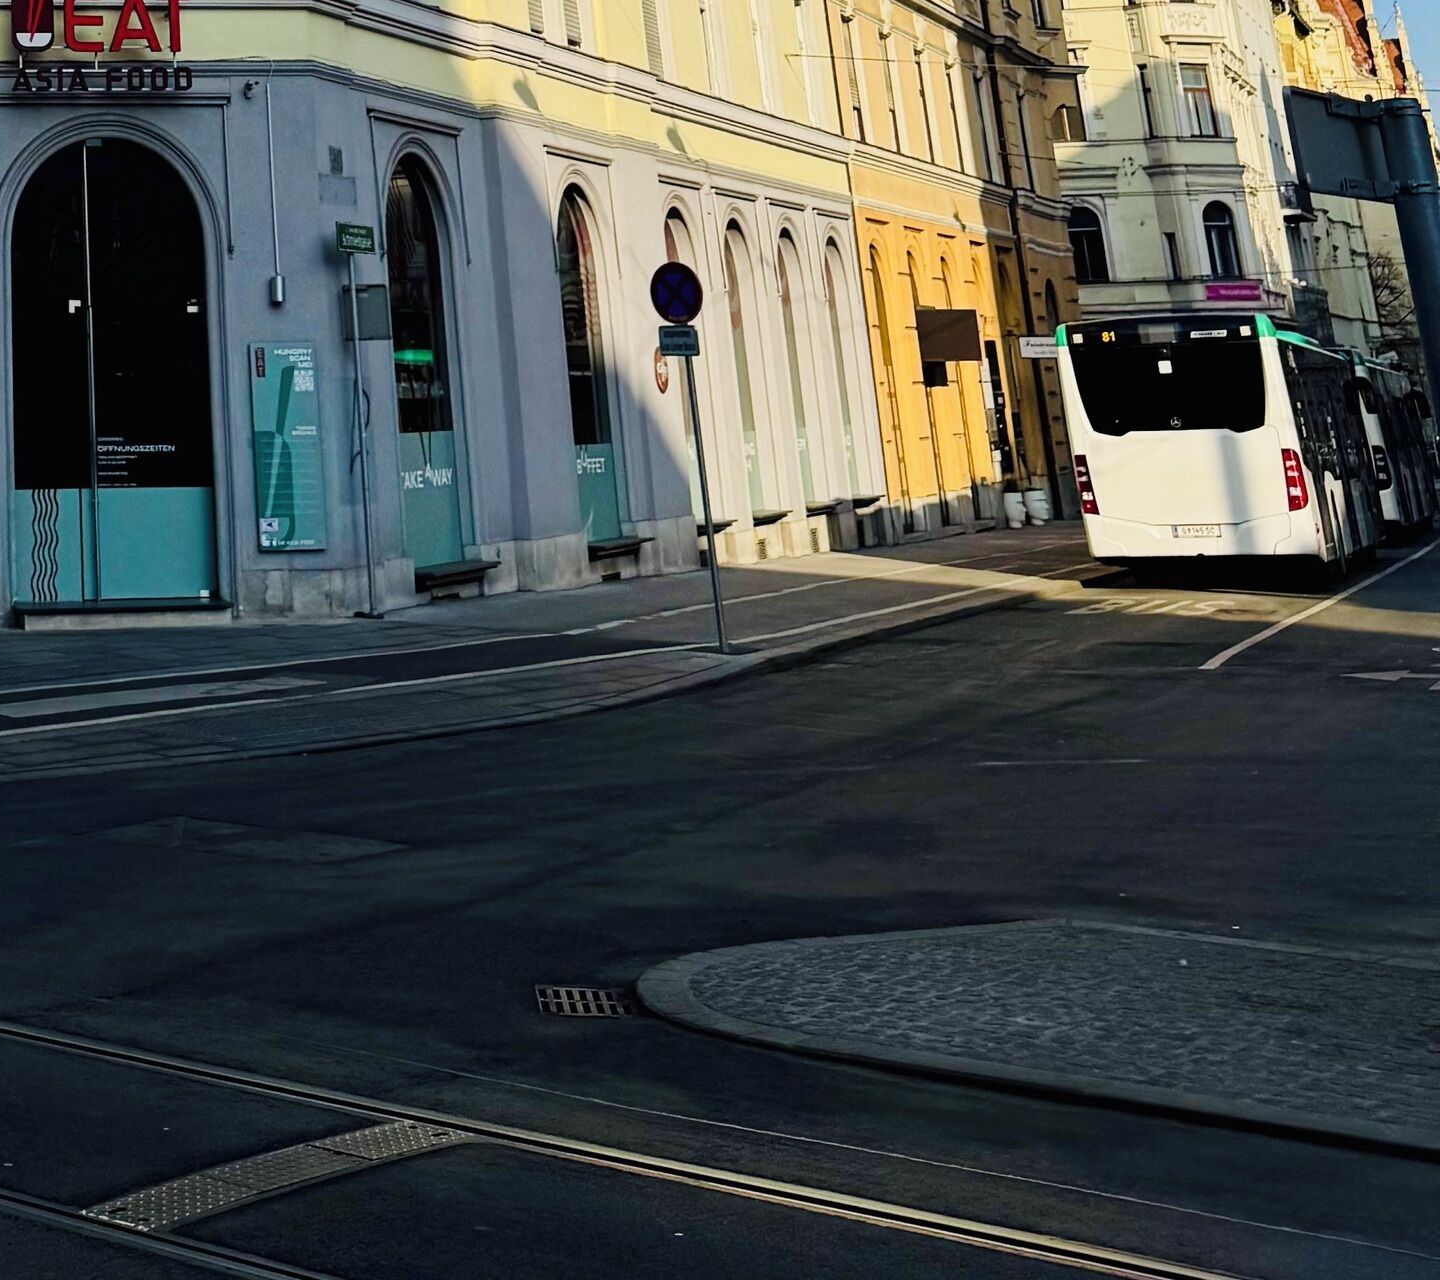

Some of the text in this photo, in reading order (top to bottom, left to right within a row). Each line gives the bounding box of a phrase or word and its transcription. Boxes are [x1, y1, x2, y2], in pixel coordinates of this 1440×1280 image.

[12, 66, 193, 92] ASIA FOOD
[1101, 330, 1116, 343] 81
[97, 444, 175, 452] ÖFFNUNGSZEITEN
[401, 471, 424, 489] AKE
[1064, 599, 1235, 617] BUS
